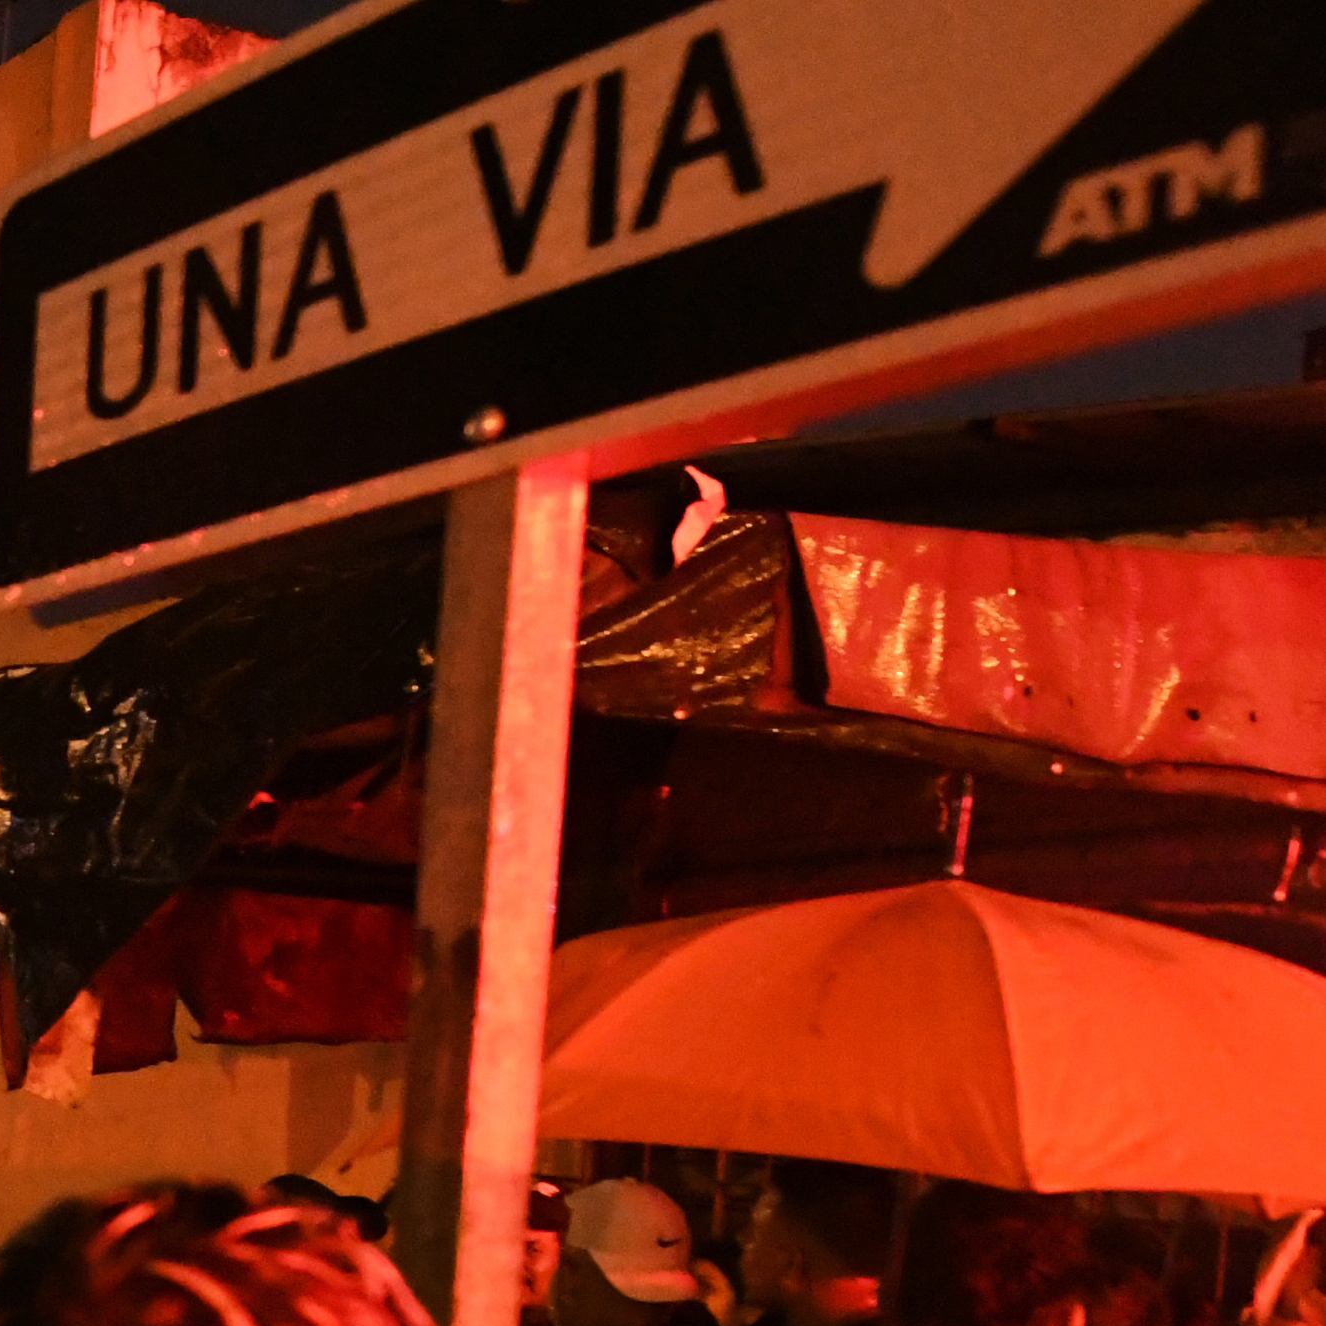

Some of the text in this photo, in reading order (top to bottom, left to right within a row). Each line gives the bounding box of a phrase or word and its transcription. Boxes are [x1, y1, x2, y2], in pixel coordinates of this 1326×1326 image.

[85, 28, 765, 420] UNA VIA
[1039, 123, 1265, 257] ATM
